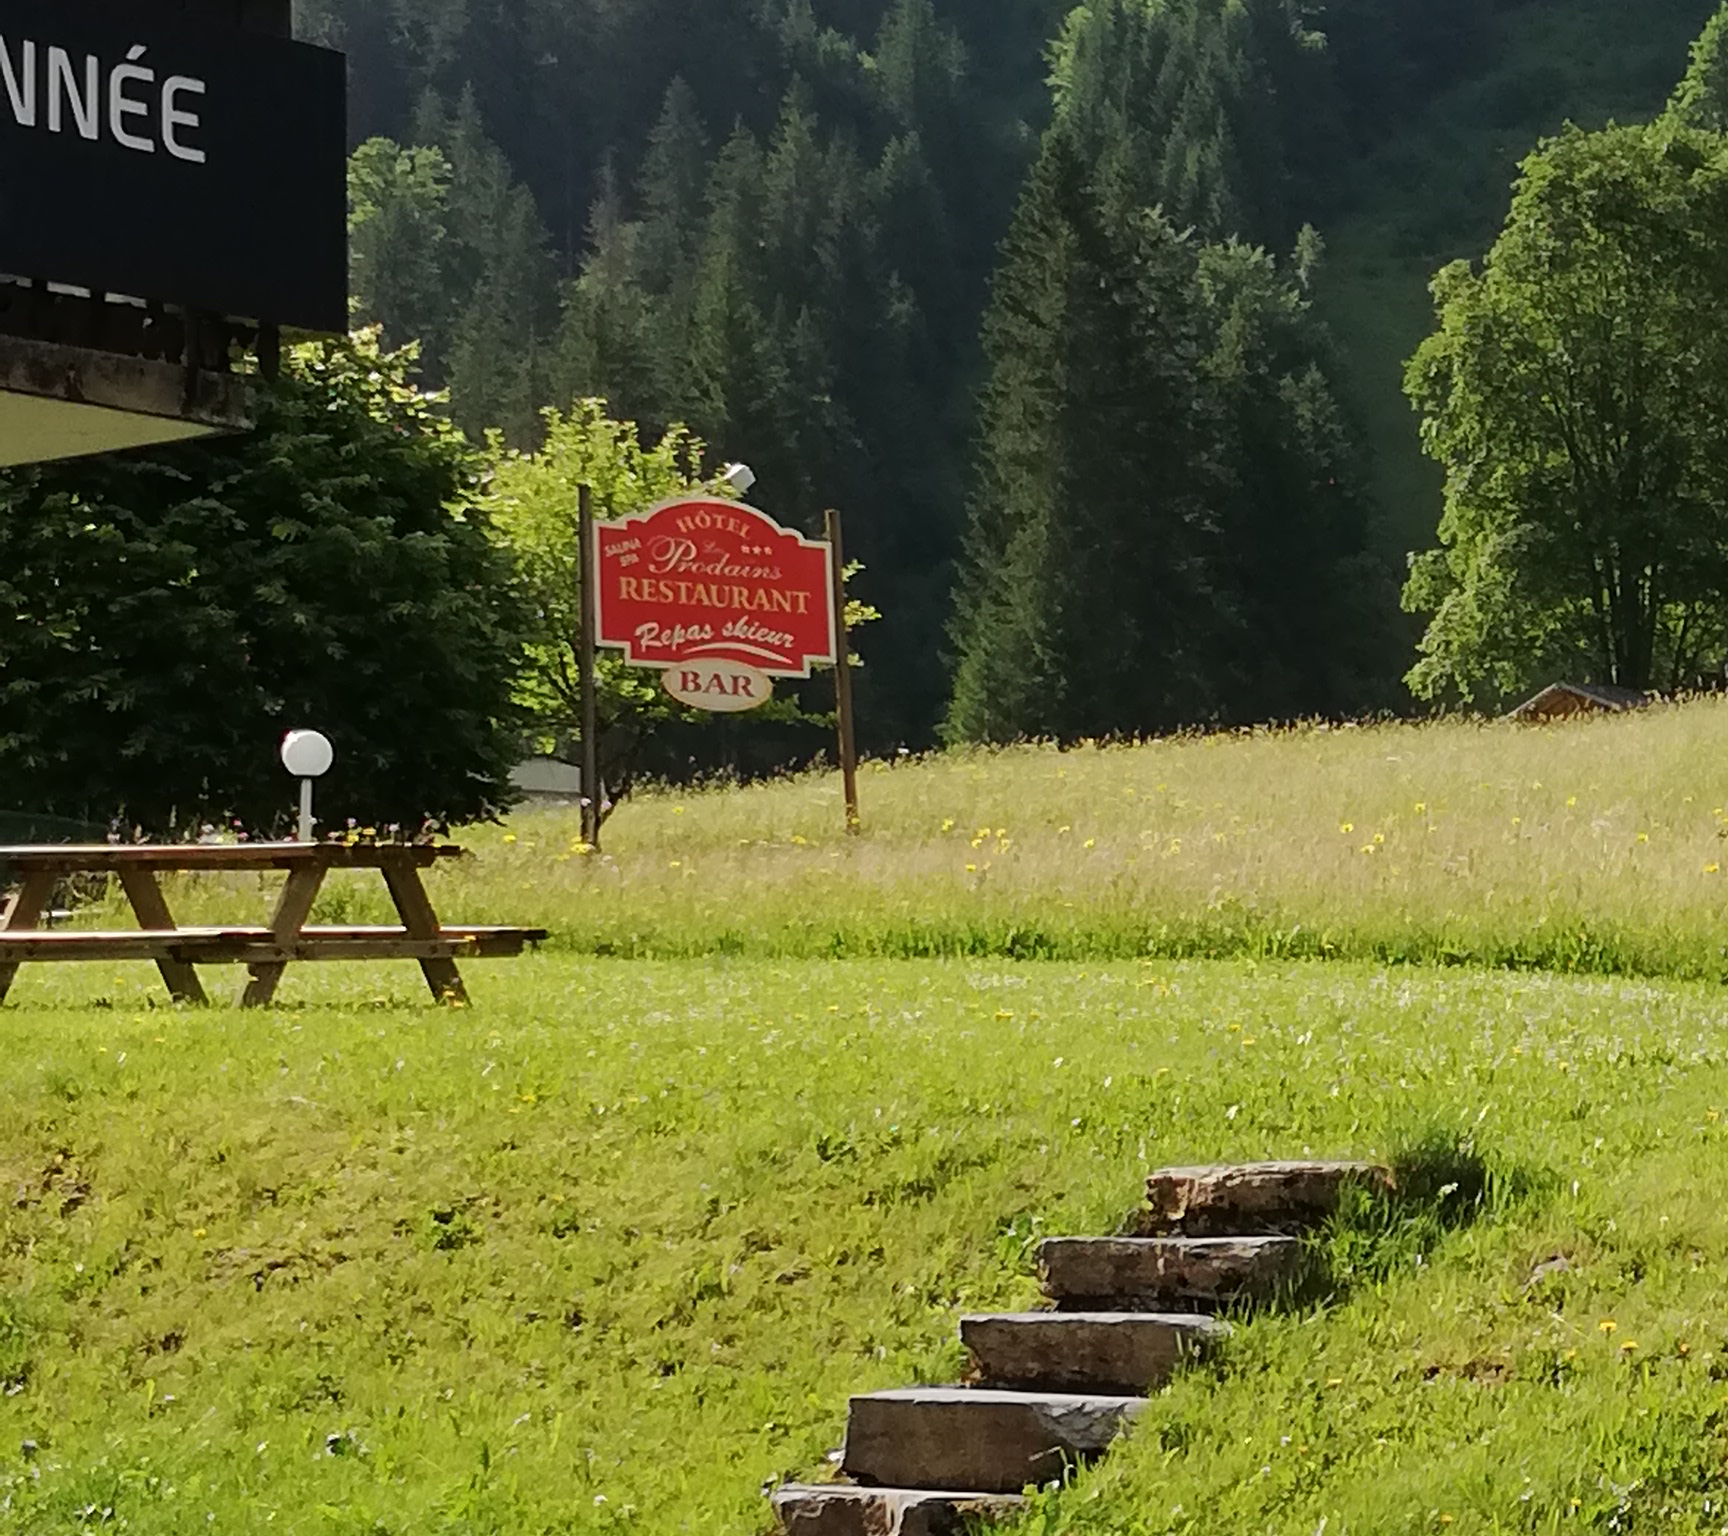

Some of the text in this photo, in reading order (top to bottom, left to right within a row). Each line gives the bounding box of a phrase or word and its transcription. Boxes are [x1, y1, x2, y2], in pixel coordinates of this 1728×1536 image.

[676, 510, 751, 540] HÔTEL
[605, 538, 642, 557] SAUNA
[646, 535, 783, 580] Prodains
[618, 576, 811, 614] RESTAURANT
[634, 615, 795, 653] Repas skieur
[680, 670, 756, 698] BAR
